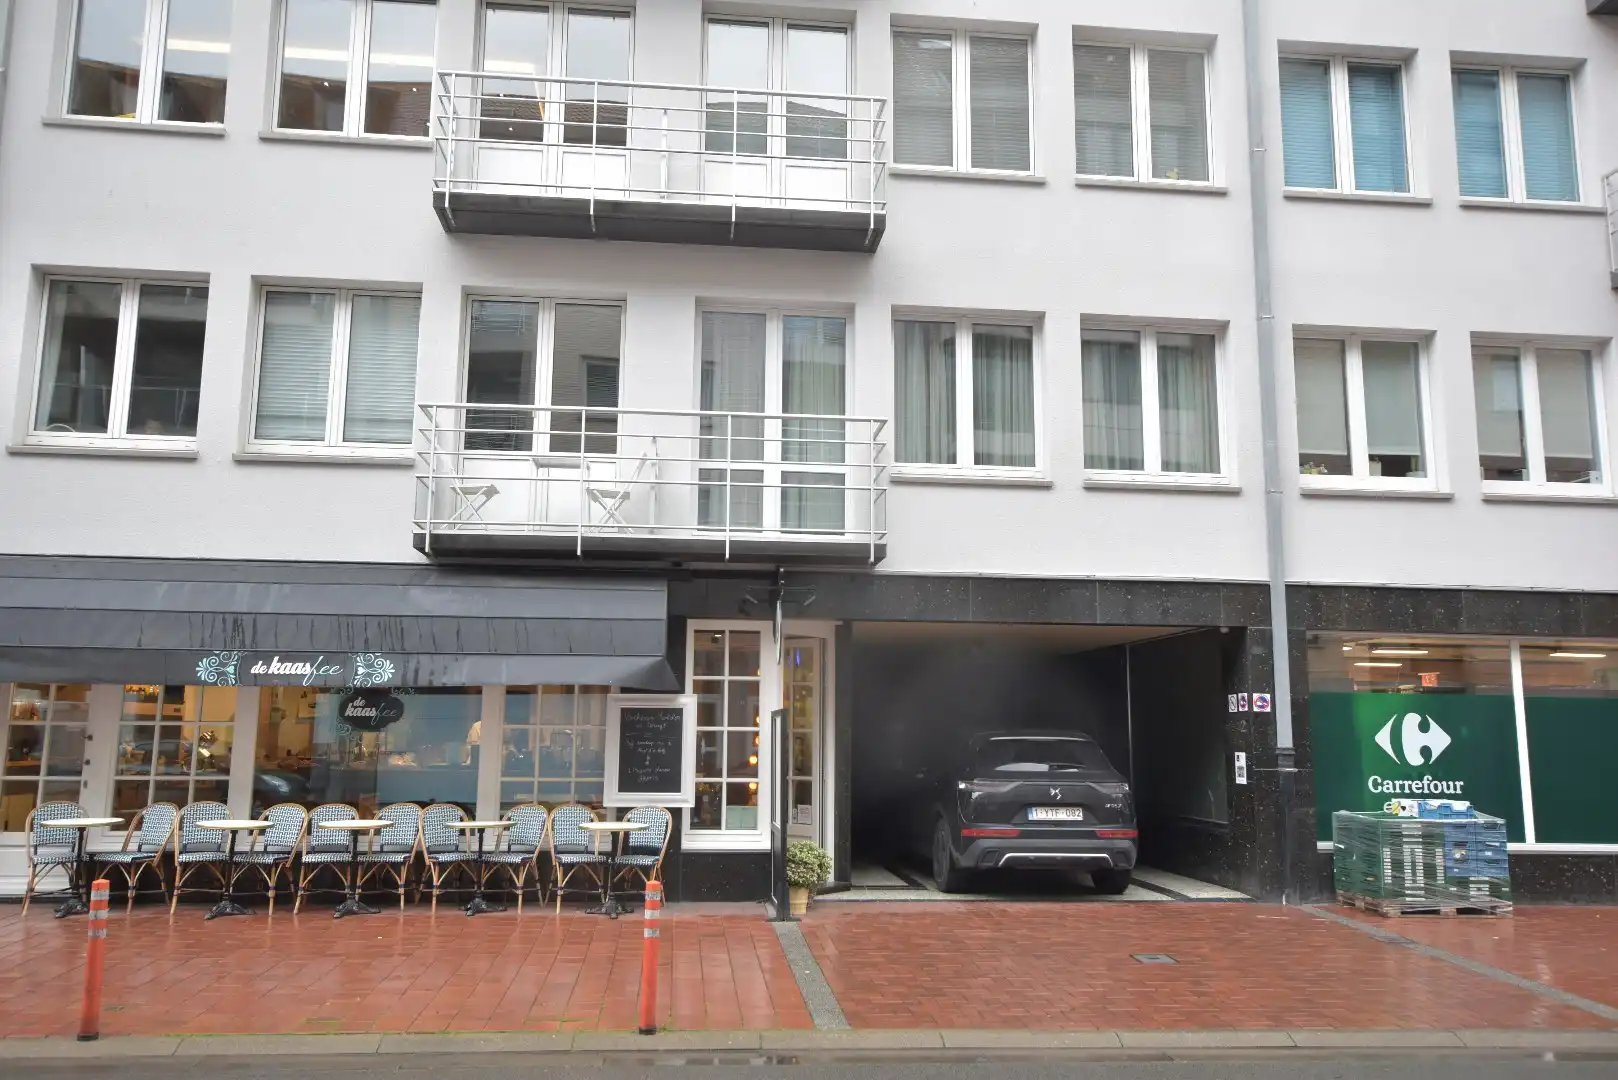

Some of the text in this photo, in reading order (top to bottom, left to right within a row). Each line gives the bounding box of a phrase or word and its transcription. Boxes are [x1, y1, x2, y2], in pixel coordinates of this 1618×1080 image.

[251, 661, 268, 674] de
[353, 696, 366, 707] de
[1368, 775, 1464, 794] Carrefour
